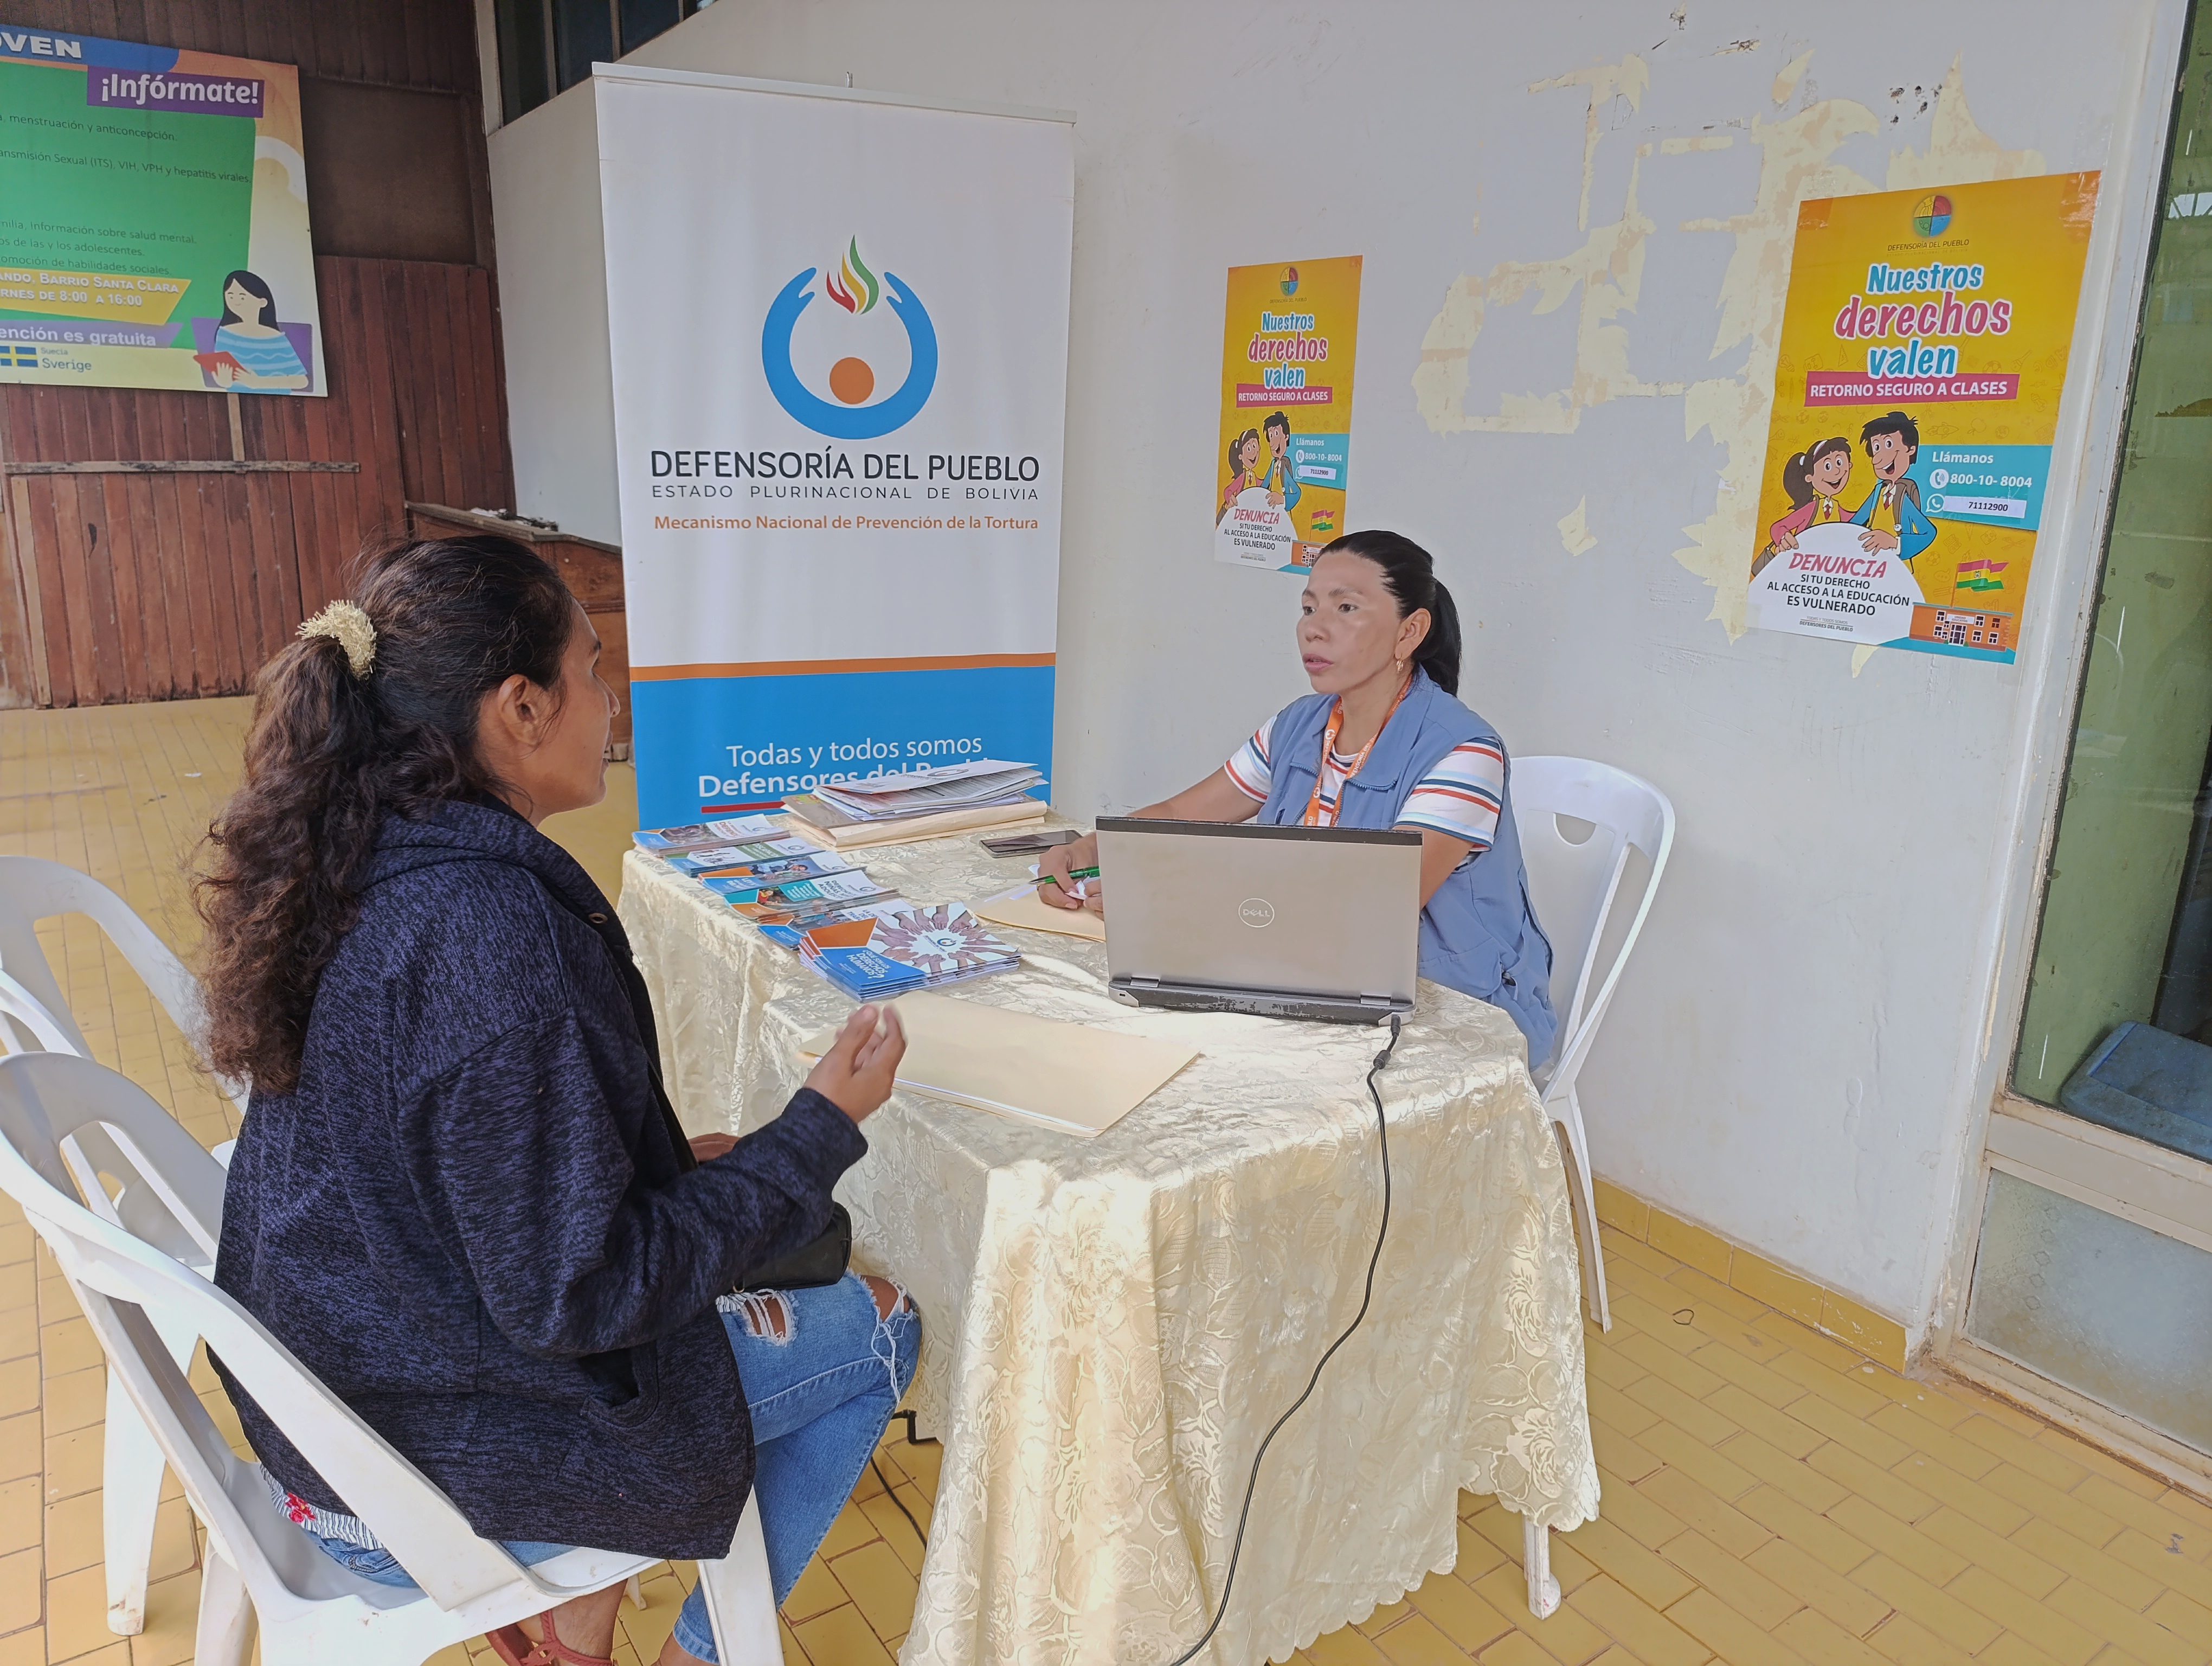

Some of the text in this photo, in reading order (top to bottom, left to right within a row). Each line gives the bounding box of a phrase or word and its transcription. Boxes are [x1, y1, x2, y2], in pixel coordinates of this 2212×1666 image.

[0, 31, 81, 58] VEN
[102, 74, 259, 105] ¡Infórmate!
[10, 114, 84, 130] menstruación
[87, 124, 93, 133] y
[97, 125, 178, 142] anticoncepción.
[54, 153, 87, 165] Sexual
[142, 163, 163, 173] VPH
[165, 168, 172, 177] y
[174, 166, 216, 180] hepatitis
[30, 221, 94, 235] Información
[98, 228, 126, 238] sobre
[130, 230, 156, 240] salud
[159, 234, 197, 244] mental.
[14, 238, 27, 247] de
[30, 239, 44, 248] las
[48, 242, 54, 251] y
[56, 241, 72, 251] los
[75, 244, 145, 257] adolescentes.
[1888, 241, 1927, 252] DEFENSORÍA
[52, 258, 65, 267] de
[68, 259, 127, 272] habilidades
[130, 265, 172, 277] sociales.
[1869, 264, 1982, 293] Nuestros
[60, 290, 88, 303] 8:00
[108, 293, 143, 307] 16:00
[1262, 312, 1314, 331] Nuestros
[1836, 292, 2010, 338] derechos
[63, 331, 85, 343] es
[89, 331, 157, 347] gratuita
[1249, 331, 1328, 362] derechos
[41, 347, 68, 356] Suecia
[1870, 340, 1956, 376] valen
[42, 358, 92, 373] Sverige
[1265, 363, 1304, 388] valen
[1238, 392, 1328, 401] RETORNO SEGURO A CLASES
[1811, 381, 2008, 397] RETORNO SEGURO A CLASES
[1296, 437, 1324, 446] Llámanos
[651, 446, 1039, 482] DEFENSORÍA DEL PUEBLO
[1328, 454, 1342, 462] 8004
[1932, 451, 1994, 464] Llámanos
[1950, 473, 2033, 488] 800-10- 8004
[652, 485, 1038, 501] ESTADO PLURINACIONAL DE BOLIVIA
[1968, 502, 2008, 511] 71112900
[655, 515, 1038, 530] Mecanismo Nacional de Prevención de la Tortura
[1233, 508, 1280, 525] DENUNCIA
[1231, 530, 1249, 538] ACCESO
[1261, 533, 1291, 543] EDUCACIÓN
[1251, 524, 1272, 533] DERECHO
[1241, 539, 1276, 550] VULNERADO
[1788, 553, 1887, 578] DENUNCIA
[1801, 574, 1870, 589] SI TU DERECHO
[1767, 581, 1910, 606] AL ACCESO A LA EDUCACIÓN
[1787, 595, 1876, 616] ES VULNERADO
[1799, 620, 1827, 629] DEFENSORES
[726, 737, 982, 769] Todas y todos somos
[1243, 908, 1271, 918] DELL
[856, 953, 888, 974] DERECHOS
